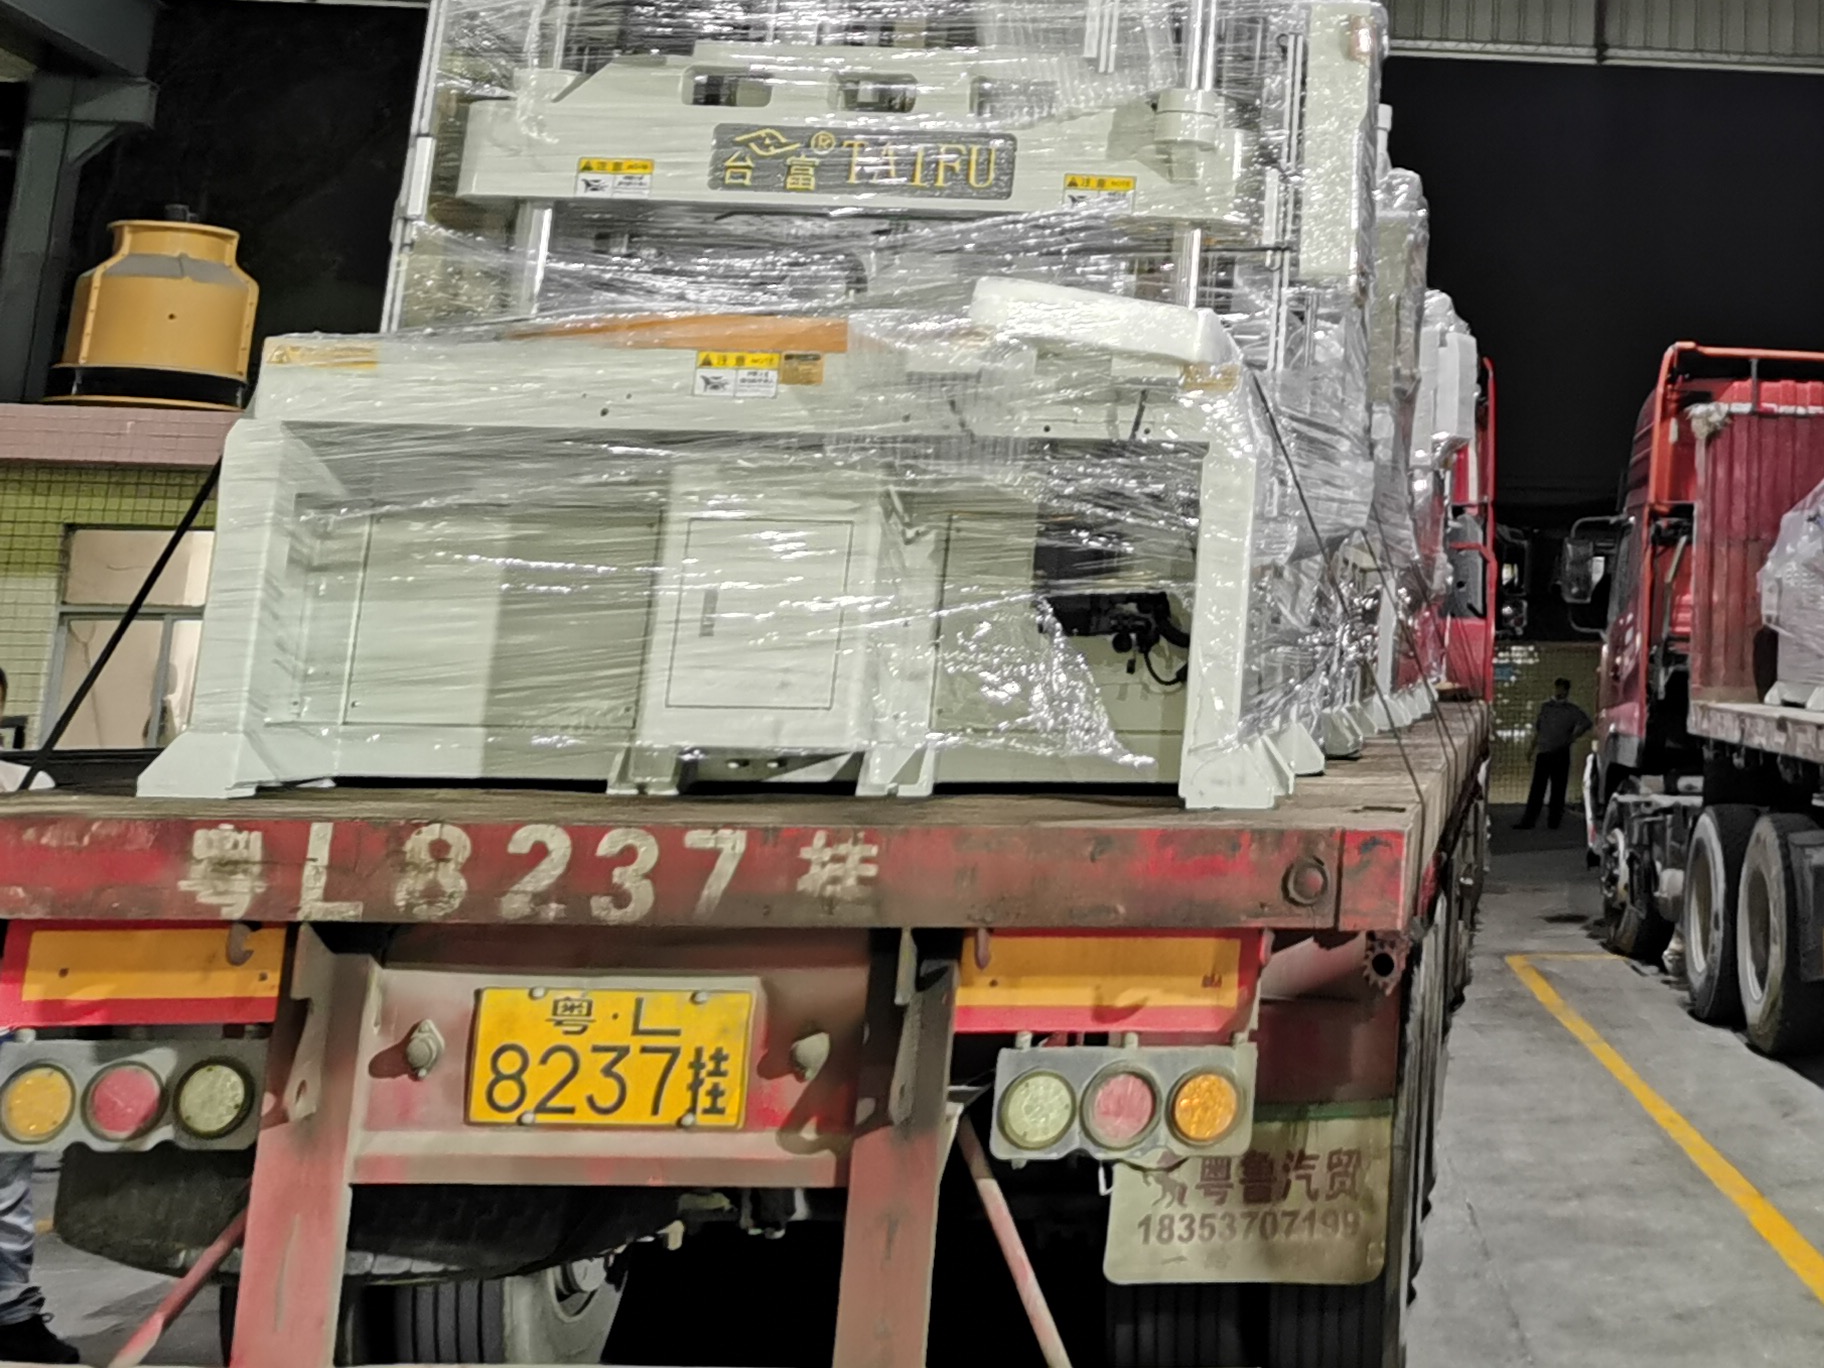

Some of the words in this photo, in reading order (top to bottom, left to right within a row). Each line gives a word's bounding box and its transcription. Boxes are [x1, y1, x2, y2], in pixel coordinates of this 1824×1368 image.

[723, 151, 820, 191] 台富
[842, 139, 997, 189] TAIFU
[485, 1042, 730, 1116] 8237挂
[1194, 1147, 1363, 1206] 粤鲁汽贸
